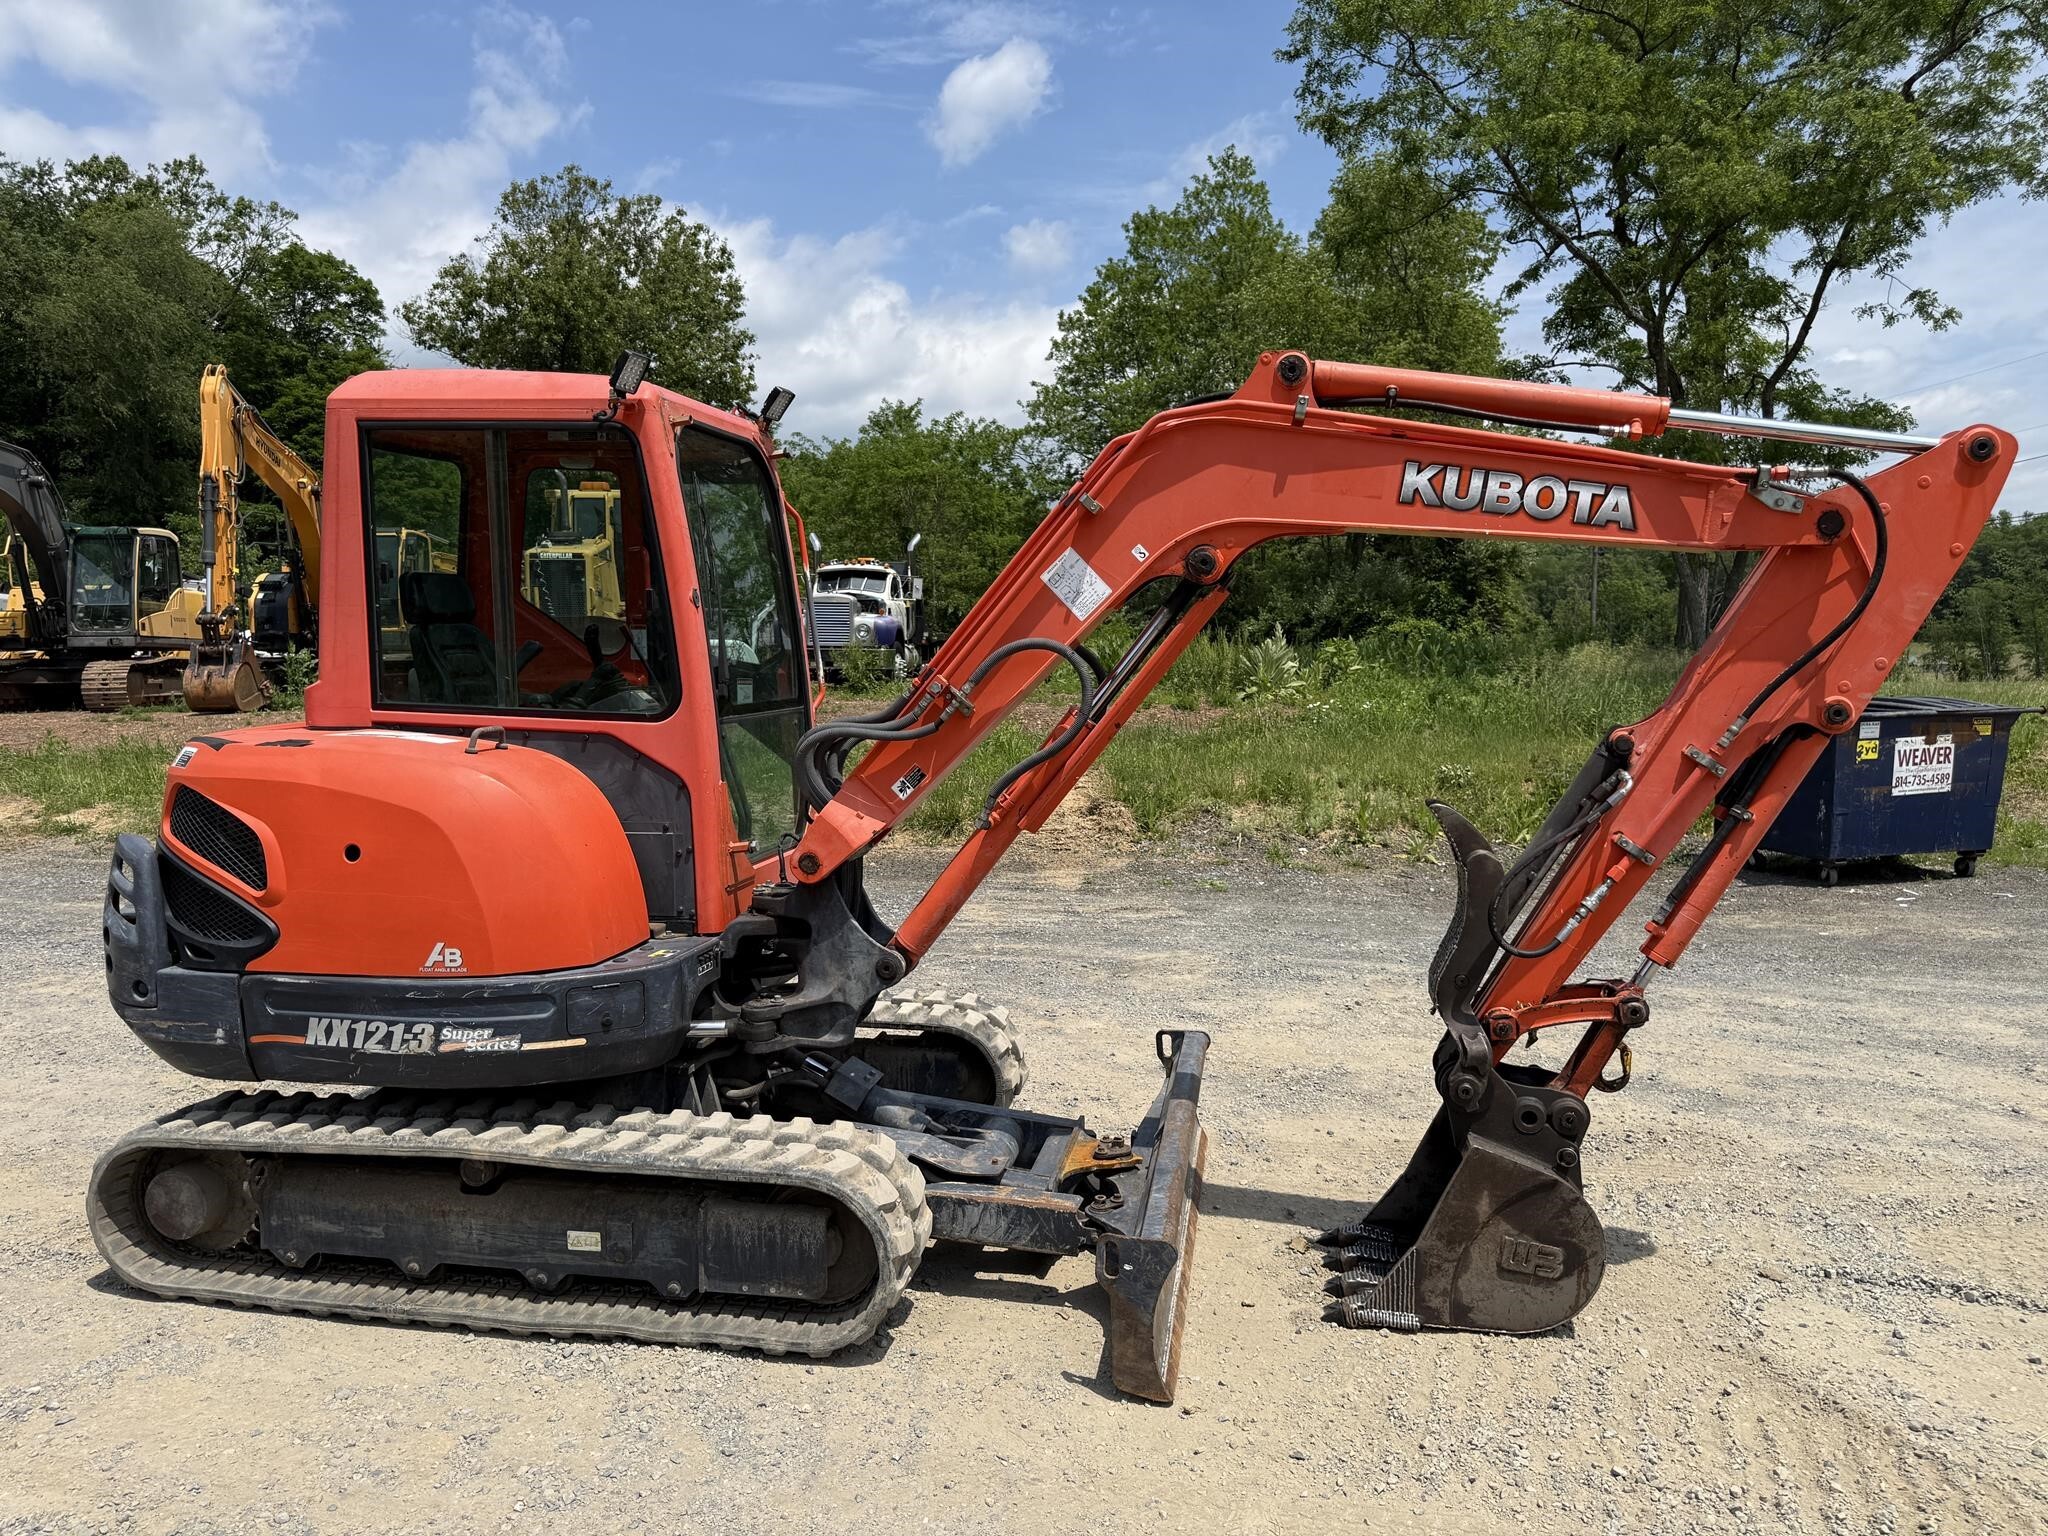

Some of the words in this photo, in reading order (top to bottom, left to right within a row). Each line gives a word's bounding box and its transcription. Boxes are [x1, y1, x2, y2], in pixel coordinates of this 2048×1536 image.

[256, 436, 281, 468] HYUNDAI
[1399, 460, 1637, 532] KUBOTA
[1897, 746, 1952, 767] WEAVER
[1895, 773, 1951, 788] 814-735-4589
[305, 1017, 434, 1051] KX121-3
[440, 1027, 493, 1041] Super
[465, 1036, 521, 1051] Series
